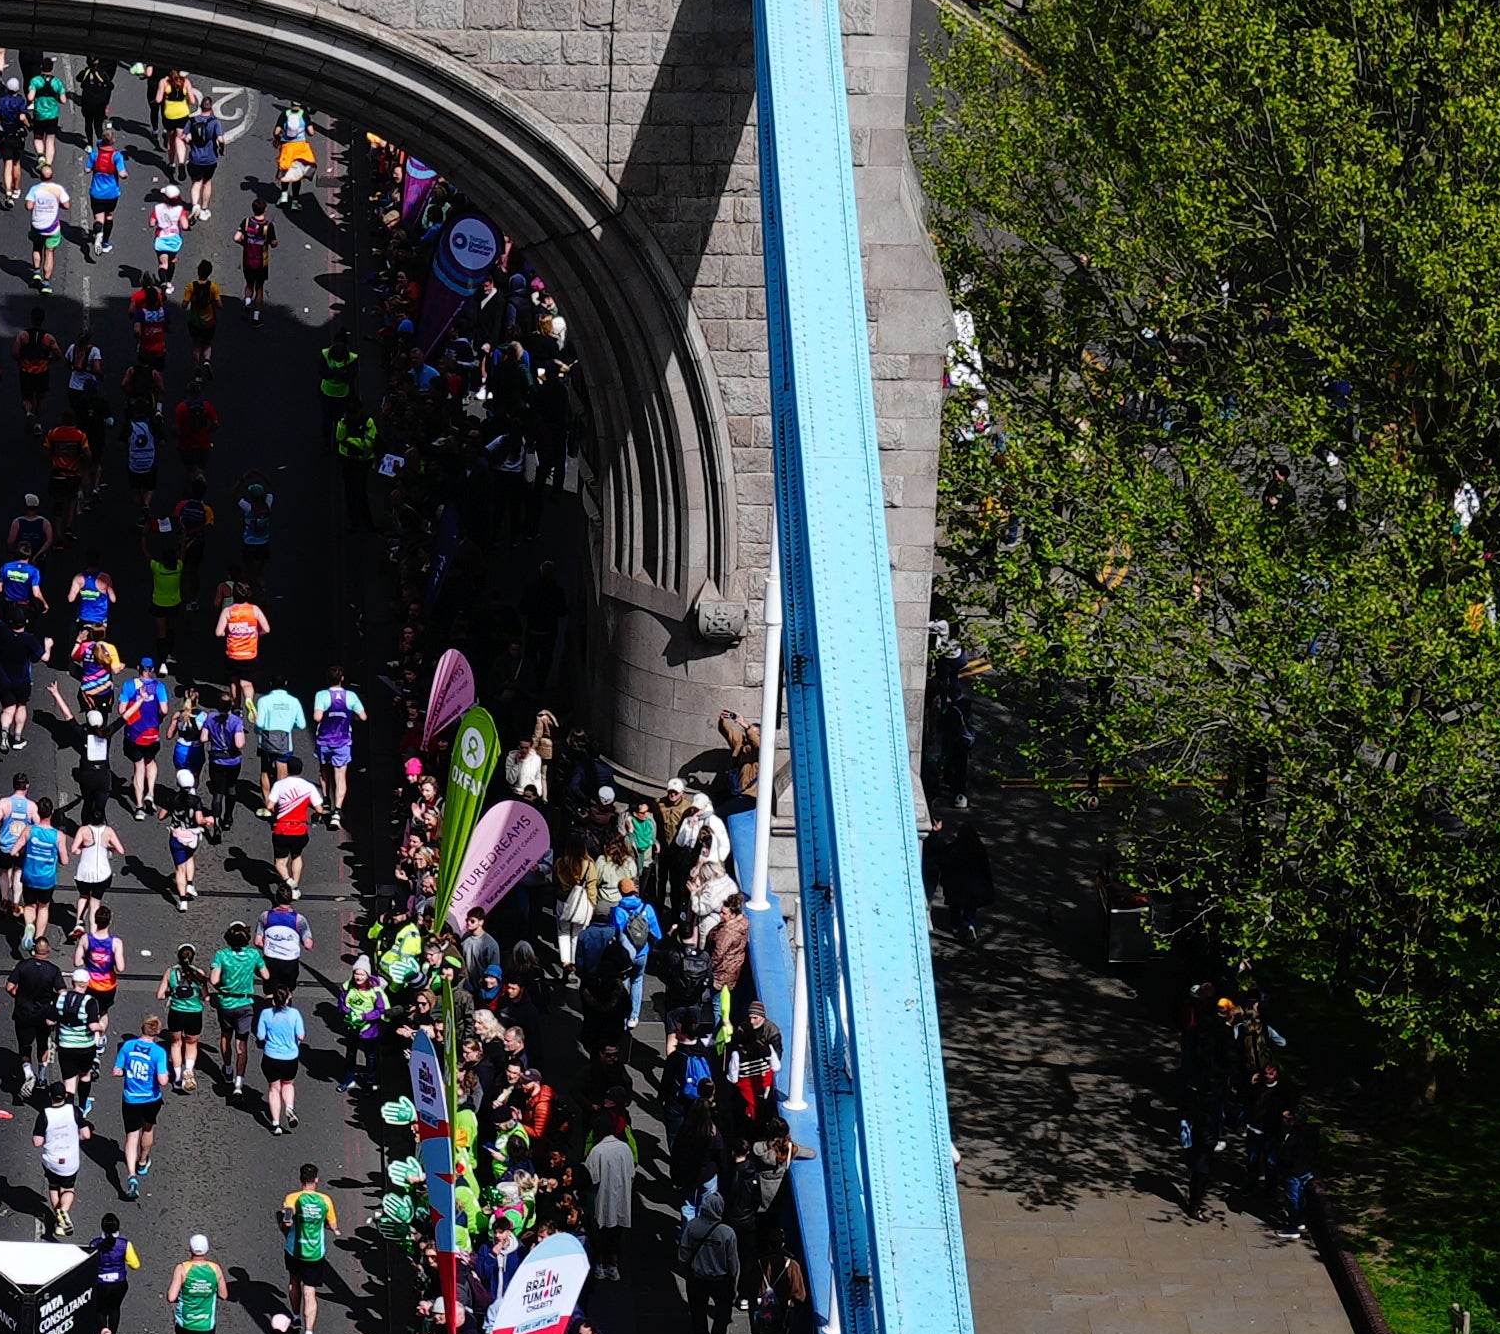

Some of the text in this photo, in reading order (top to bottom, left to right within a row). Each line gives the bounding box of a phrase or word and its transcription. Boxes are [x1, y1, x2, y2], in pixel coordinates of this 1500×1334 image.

[520, 826, 540, 849] CANCER
[38, 1287, 93, 1334] CONSULTANCY
[39, 1294, 64, 1318] TATA
[526, 1299, 553, 1313] CHARITY
